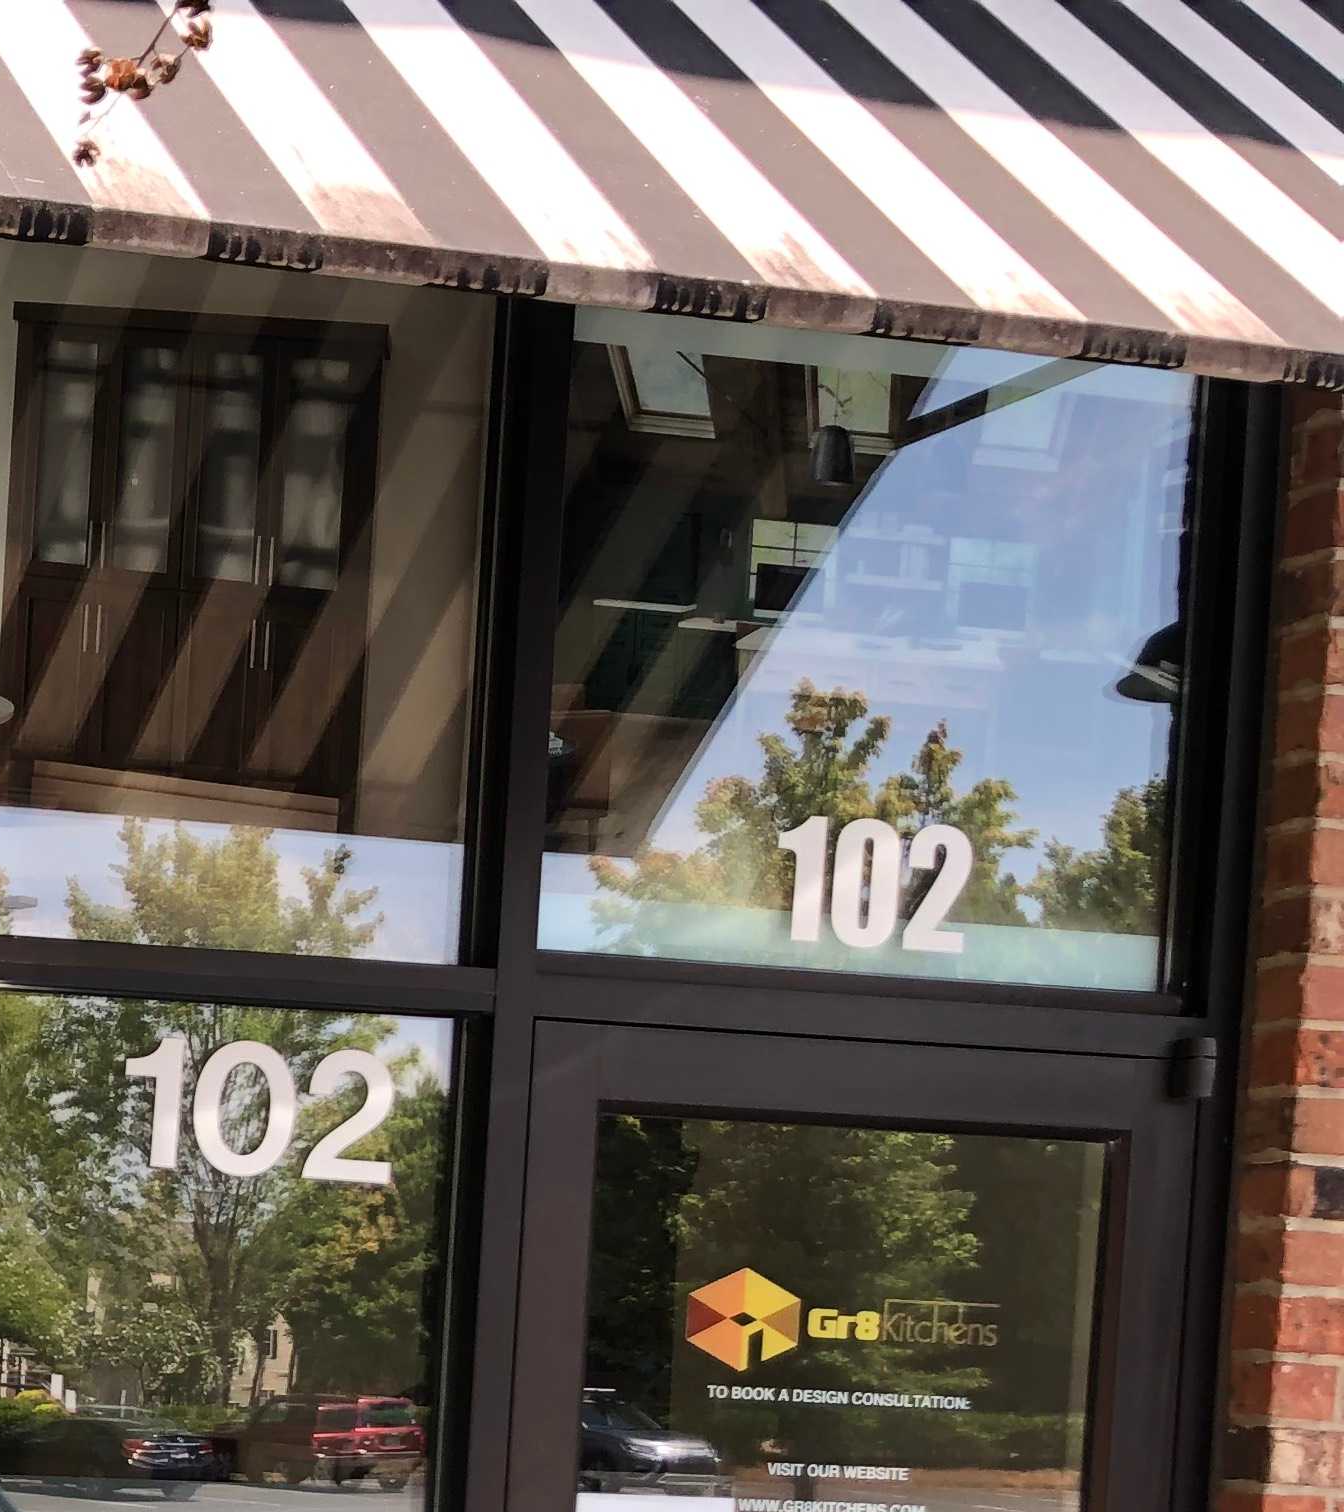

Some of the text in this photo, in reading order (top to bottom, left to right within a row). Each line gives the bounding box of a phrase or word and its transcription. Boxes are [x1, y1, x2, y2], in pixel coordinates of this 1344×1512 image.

[778, 815, 973, 953] 102
[124, 1036, 395, 1186] 102
[707, 1384, 973, 1411] TO BOOK A DESIGN CONSULTATION:
[767, 1462, 912, 1481] VISIT OUR WEBSITE
